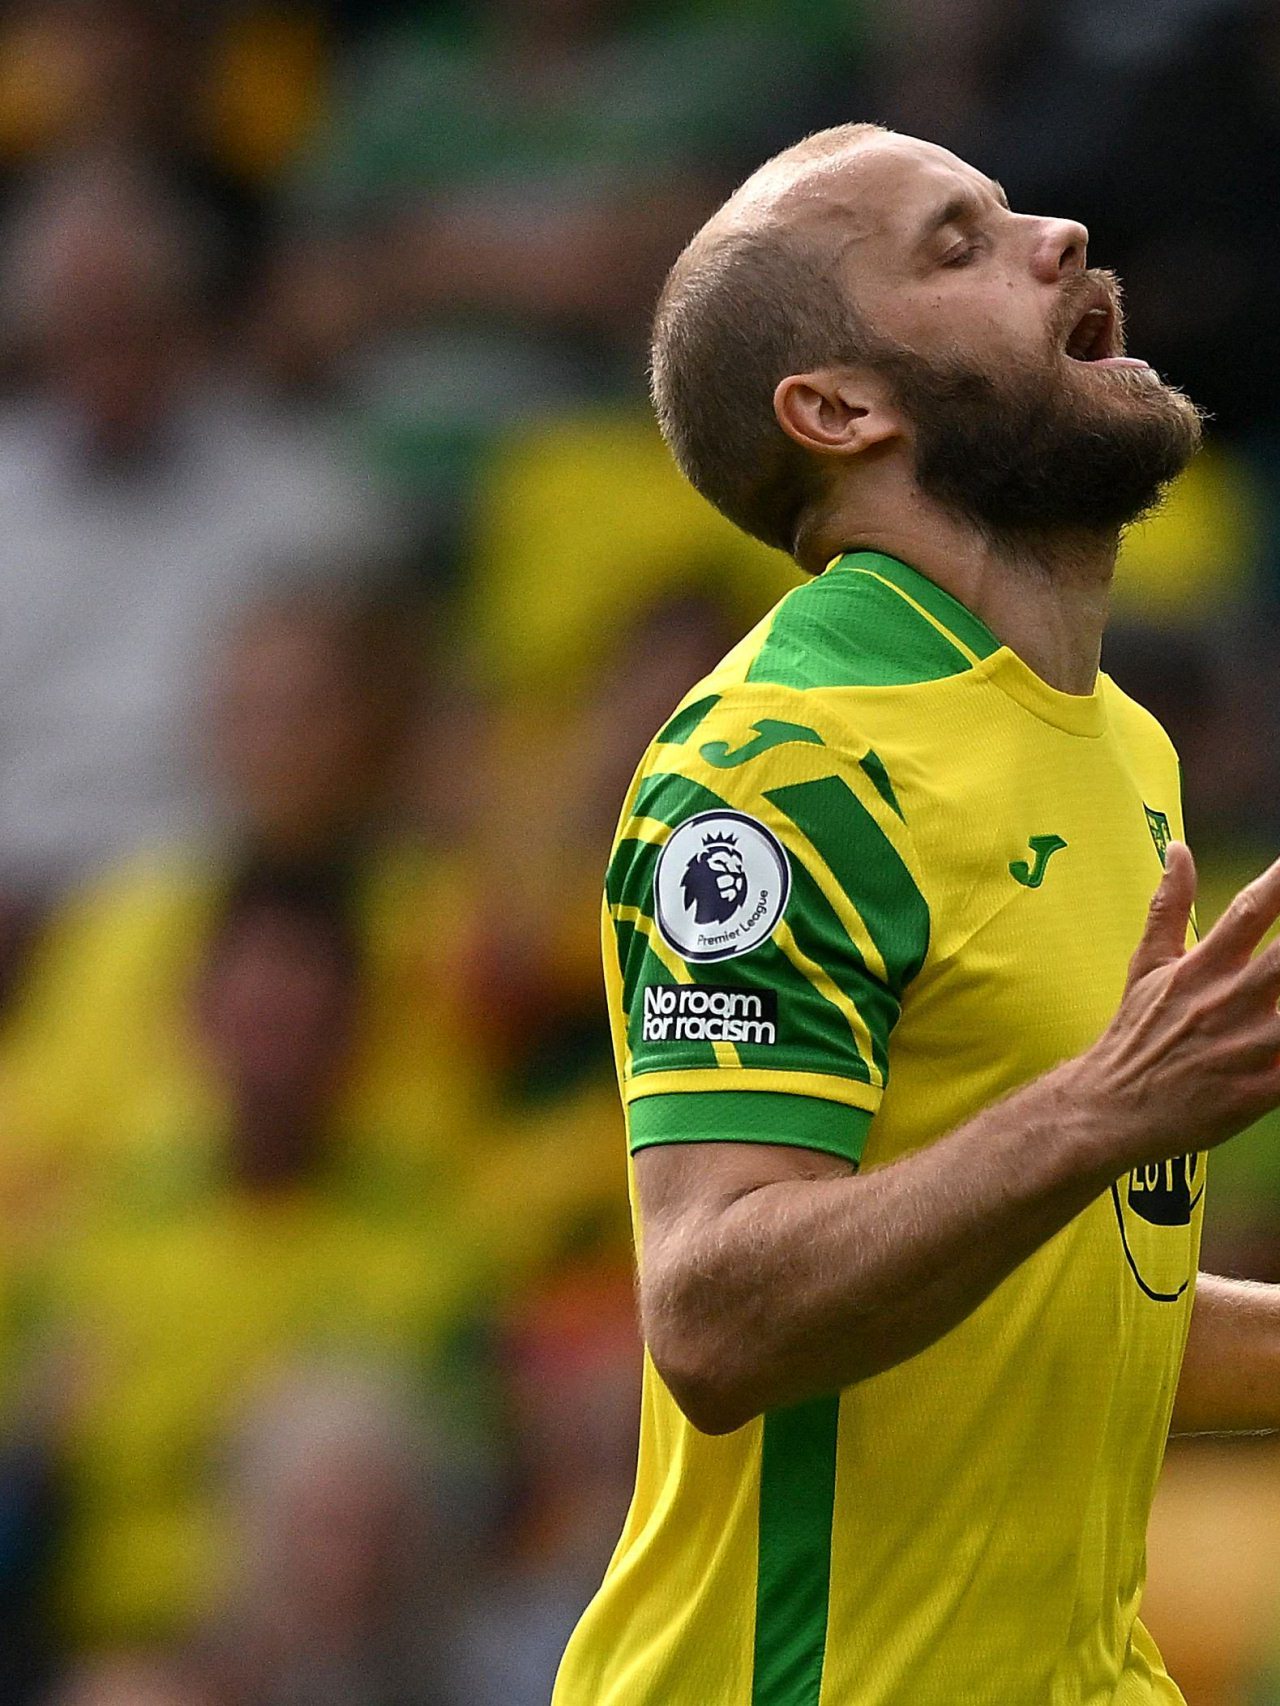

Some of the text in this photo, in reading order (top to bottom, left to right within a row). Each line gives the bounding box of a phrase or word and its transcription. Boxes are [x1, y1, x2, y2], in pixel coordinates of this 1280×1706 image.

[697, 889, 769, 946] Premier League
[644, 985, 761, 1017] No room
[643, 1012, 775, 1044] for racism
